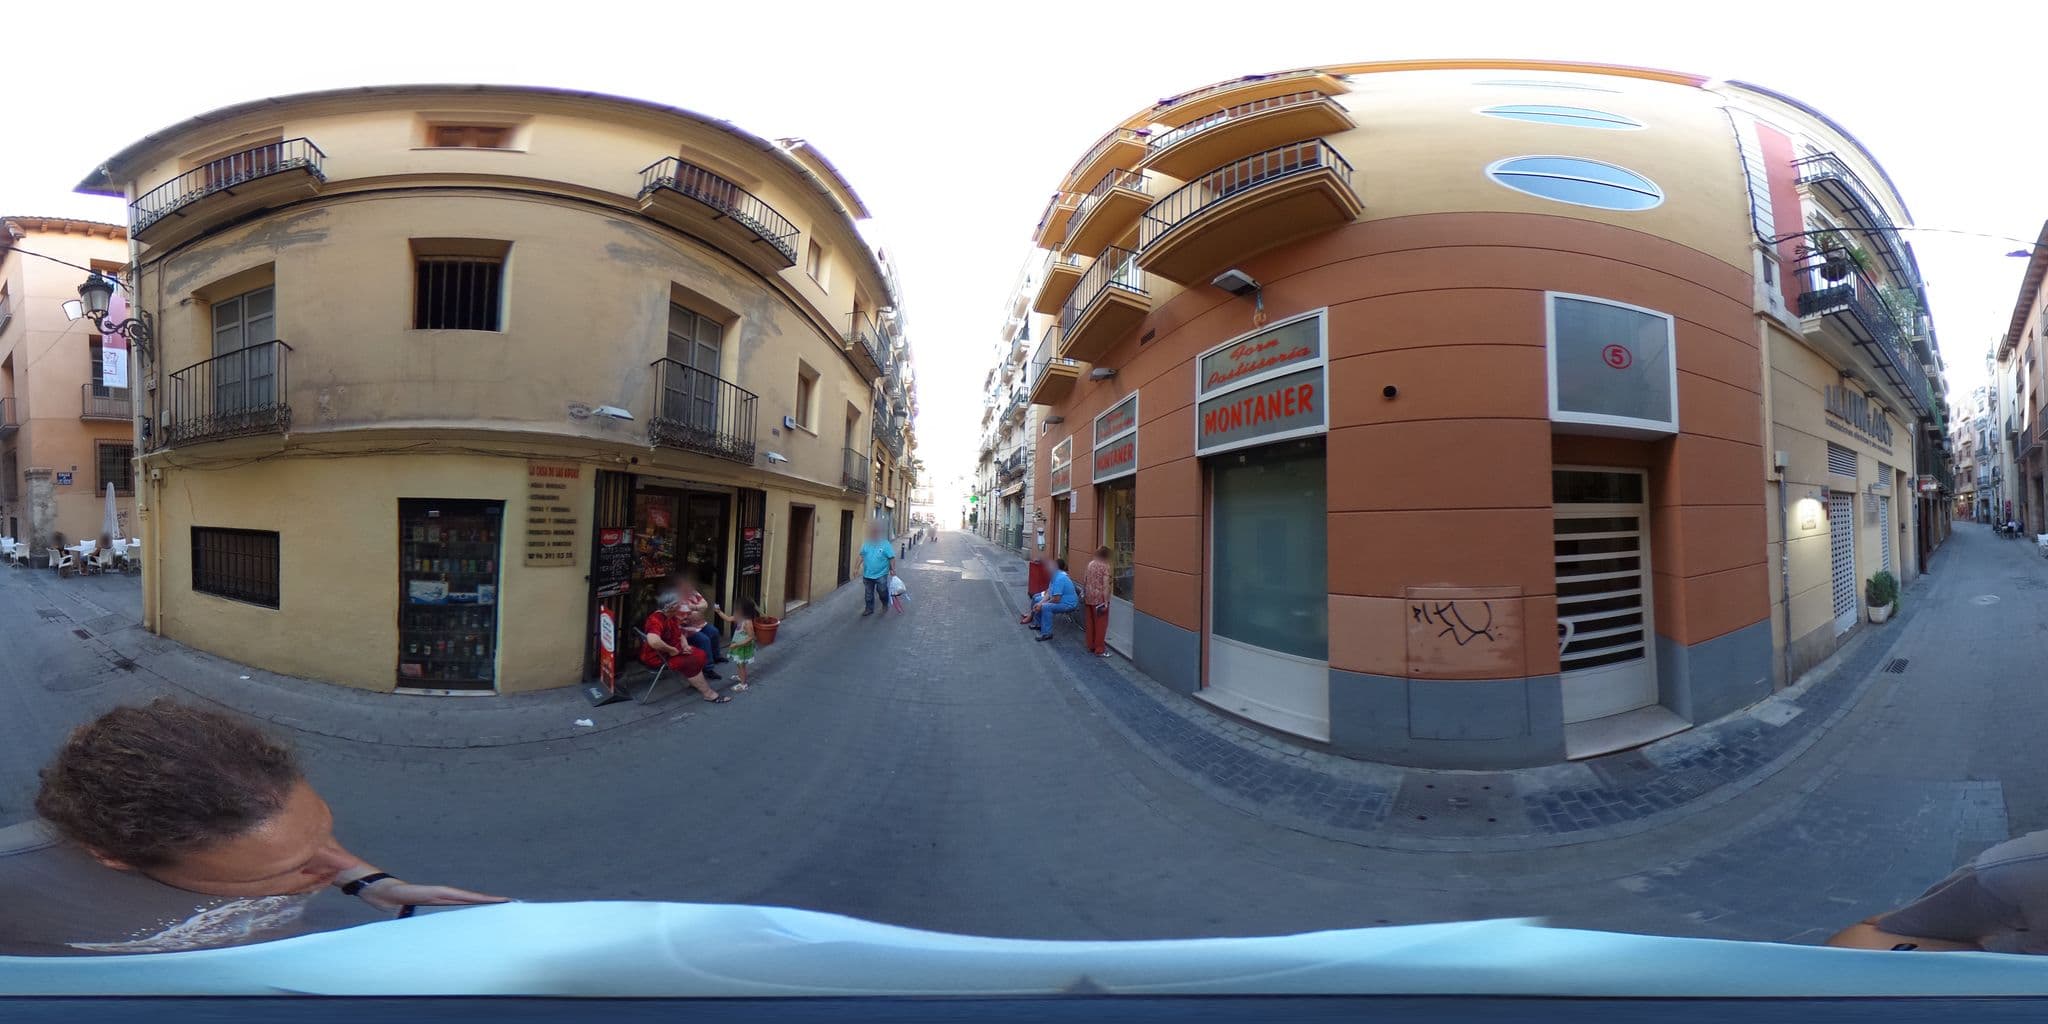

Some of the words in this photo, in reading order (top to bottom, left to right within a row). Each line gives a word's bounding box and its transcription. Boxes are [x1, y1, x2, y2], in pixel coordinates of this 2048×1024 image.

[1611, 348, 1624, 365] 5
[1203, 383, 1314, 437] MONTANER
[1096, 442, 1134, 471] MONTANER
